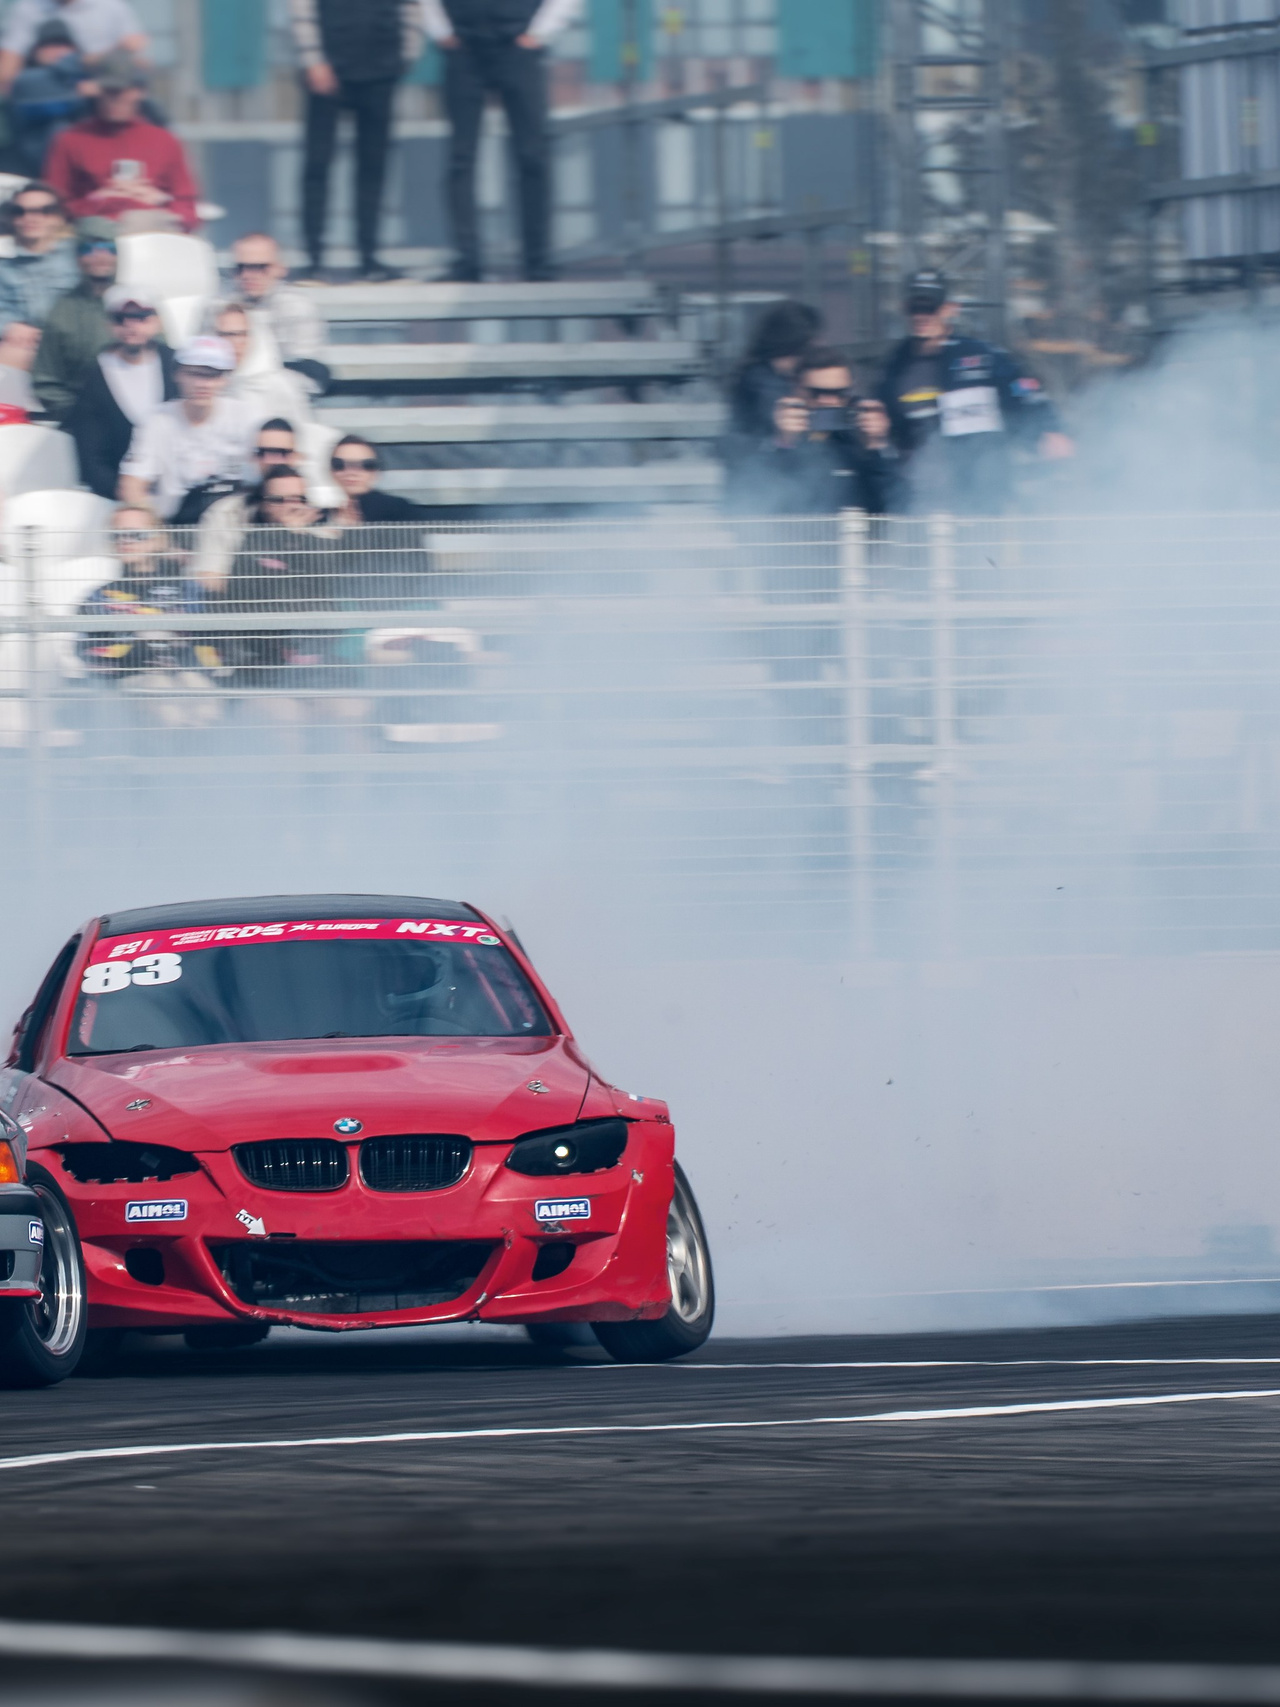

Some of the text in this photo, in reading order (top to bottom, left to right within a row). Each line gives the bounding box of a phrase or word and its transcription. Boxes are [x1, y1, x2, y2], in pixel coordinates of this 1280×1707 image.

[214, 921, 488, 941] RDS EUROPE NXT
[81, 952, 183, 995] 83
[128, 1204, 184, 1218] AIMOL
[538, 1203, 588, 1217] AIMOL
